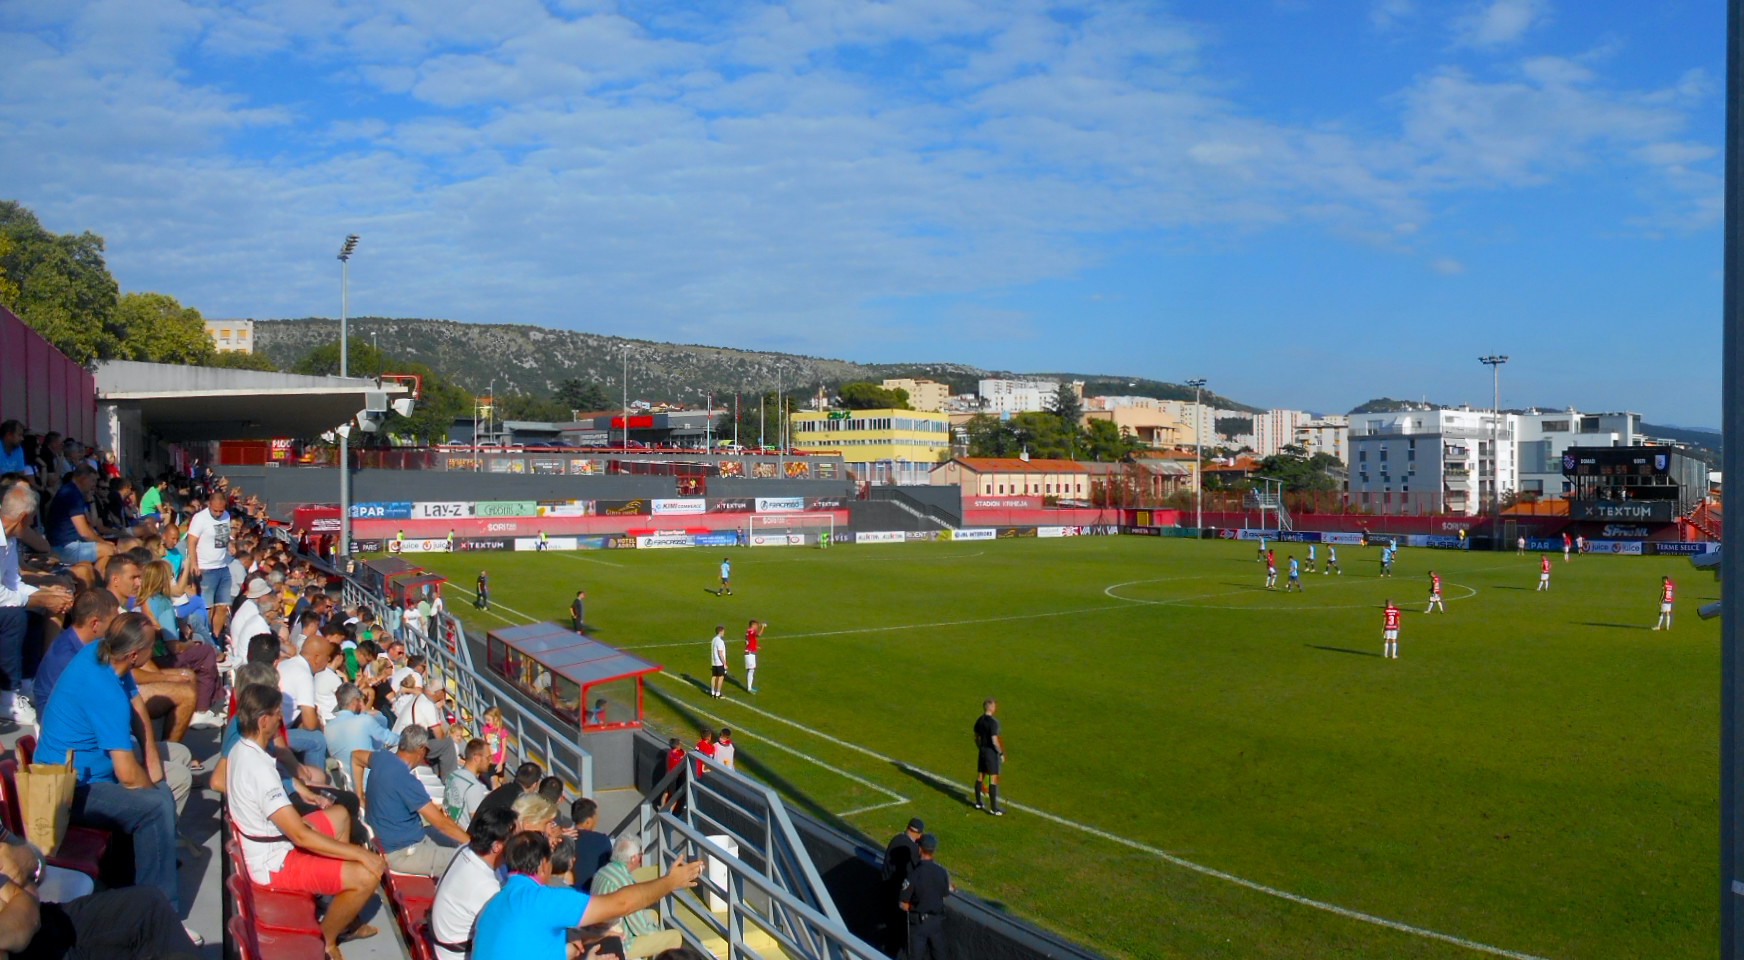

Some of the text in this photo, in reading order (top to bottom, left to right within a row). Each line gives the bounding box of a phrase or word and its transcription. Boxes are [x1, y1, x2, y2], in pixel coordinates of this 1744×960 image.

[827, 411, 851, 419] CRUZ
[360, 507, 385, 517] PAR
[1599, 507, 1652, 517] TEXTUM
[470, 541, 504, 549] TEXTUM
[1656, 543, 1679, 551] TERME
[1388, 615, 1395, 625] 3
